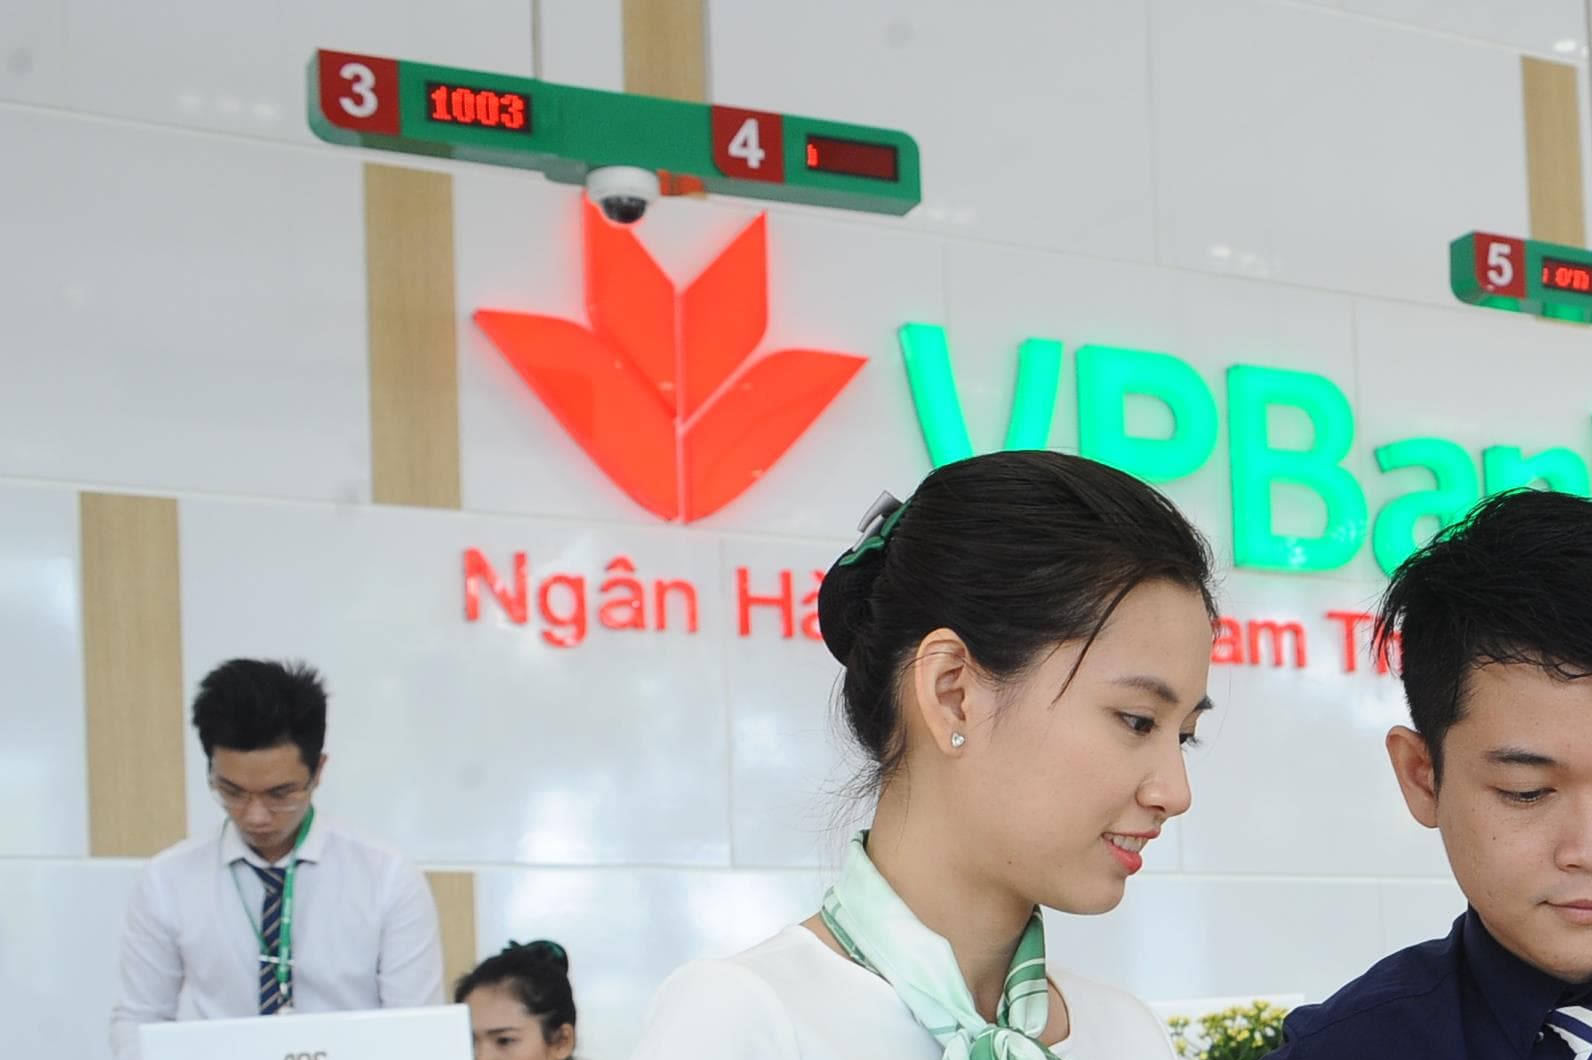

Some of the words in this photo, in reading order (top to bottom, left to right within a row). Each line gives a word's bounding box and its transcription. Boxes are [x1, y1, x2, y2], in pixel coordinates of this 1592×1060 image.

[338, 62, 378, 117] 3
[430, 84, 525, 129] 1003
[727, 118, 766, 168] 4
[1487, 242, 1513, 286] 5
[462, 546, 699, 648] Ngân
[1211, 612, 1308, 668] am
